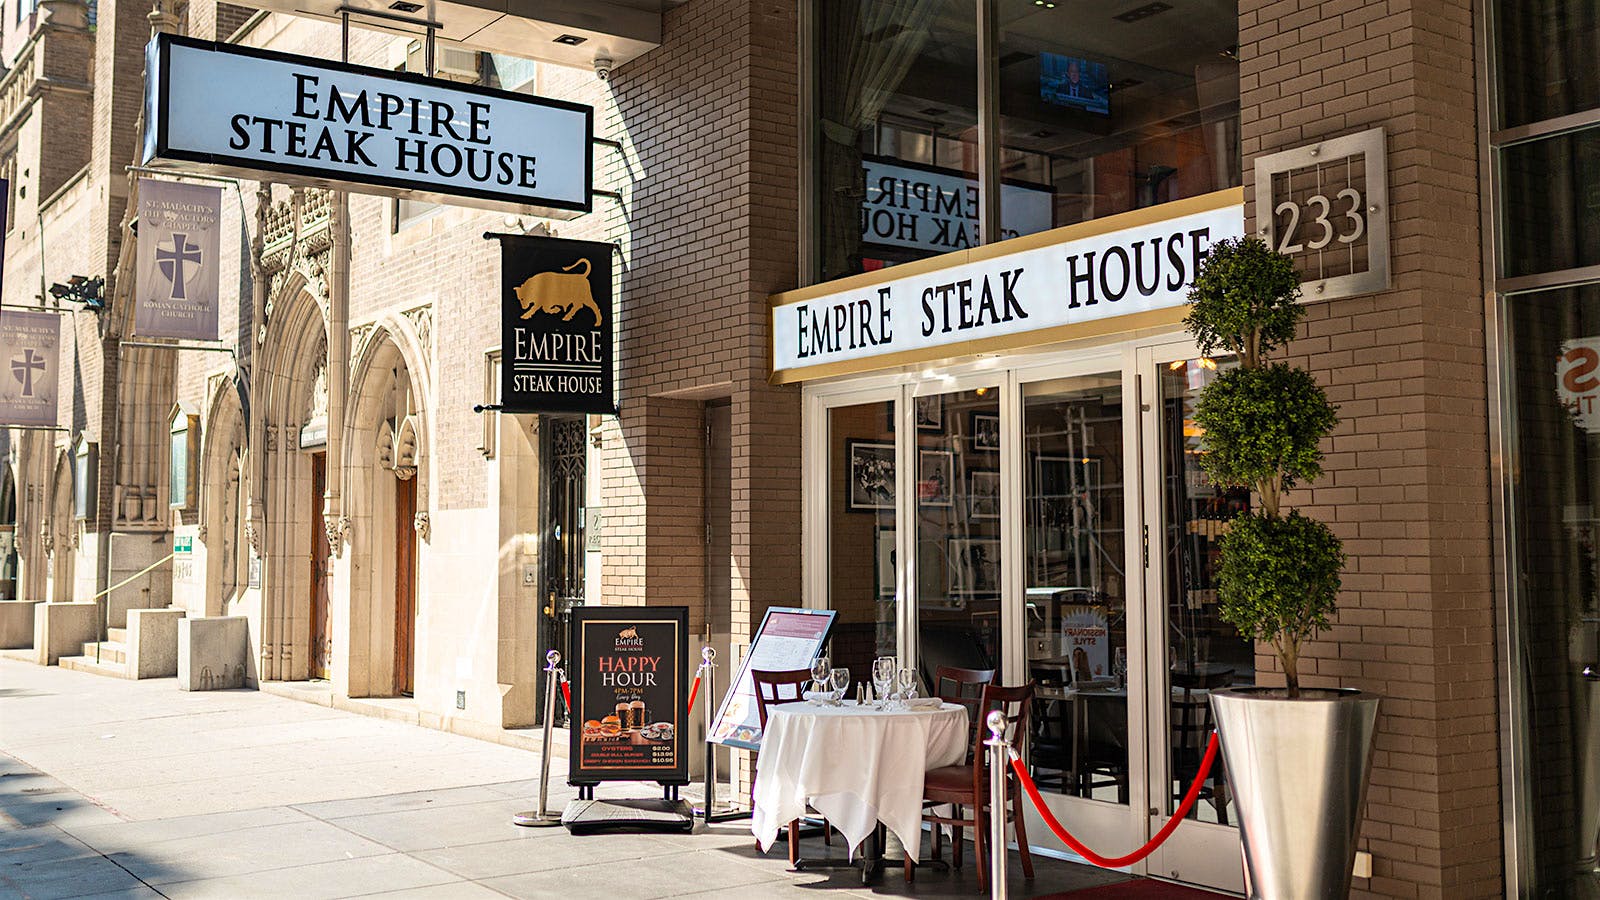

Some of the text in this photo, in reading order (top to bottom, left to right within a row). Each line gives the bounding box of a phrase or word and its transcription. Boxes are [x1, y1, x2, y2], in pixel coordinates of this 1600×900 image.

[291, 72, 492, 145] EMPIRE
[229, 114, 537, 189] STEAK HOUSE
[1275, 188, 1364, 255] 233
[797, 227, 1210, 359] EMPIRE STEAK HOUSE
[143, 301, 212, 313] ROMAN CATHOLIC
[161, 310, 194, 319] CHURCH
[514, 327, 602, 363] EMPIRE
[513, 374, 602, 394] STEAK HOUSE
[615, 637, 643, 647] EMPIRE
[599, 656, 661, 672] HAPPY
[602, 672, 657, 687] HOUR
